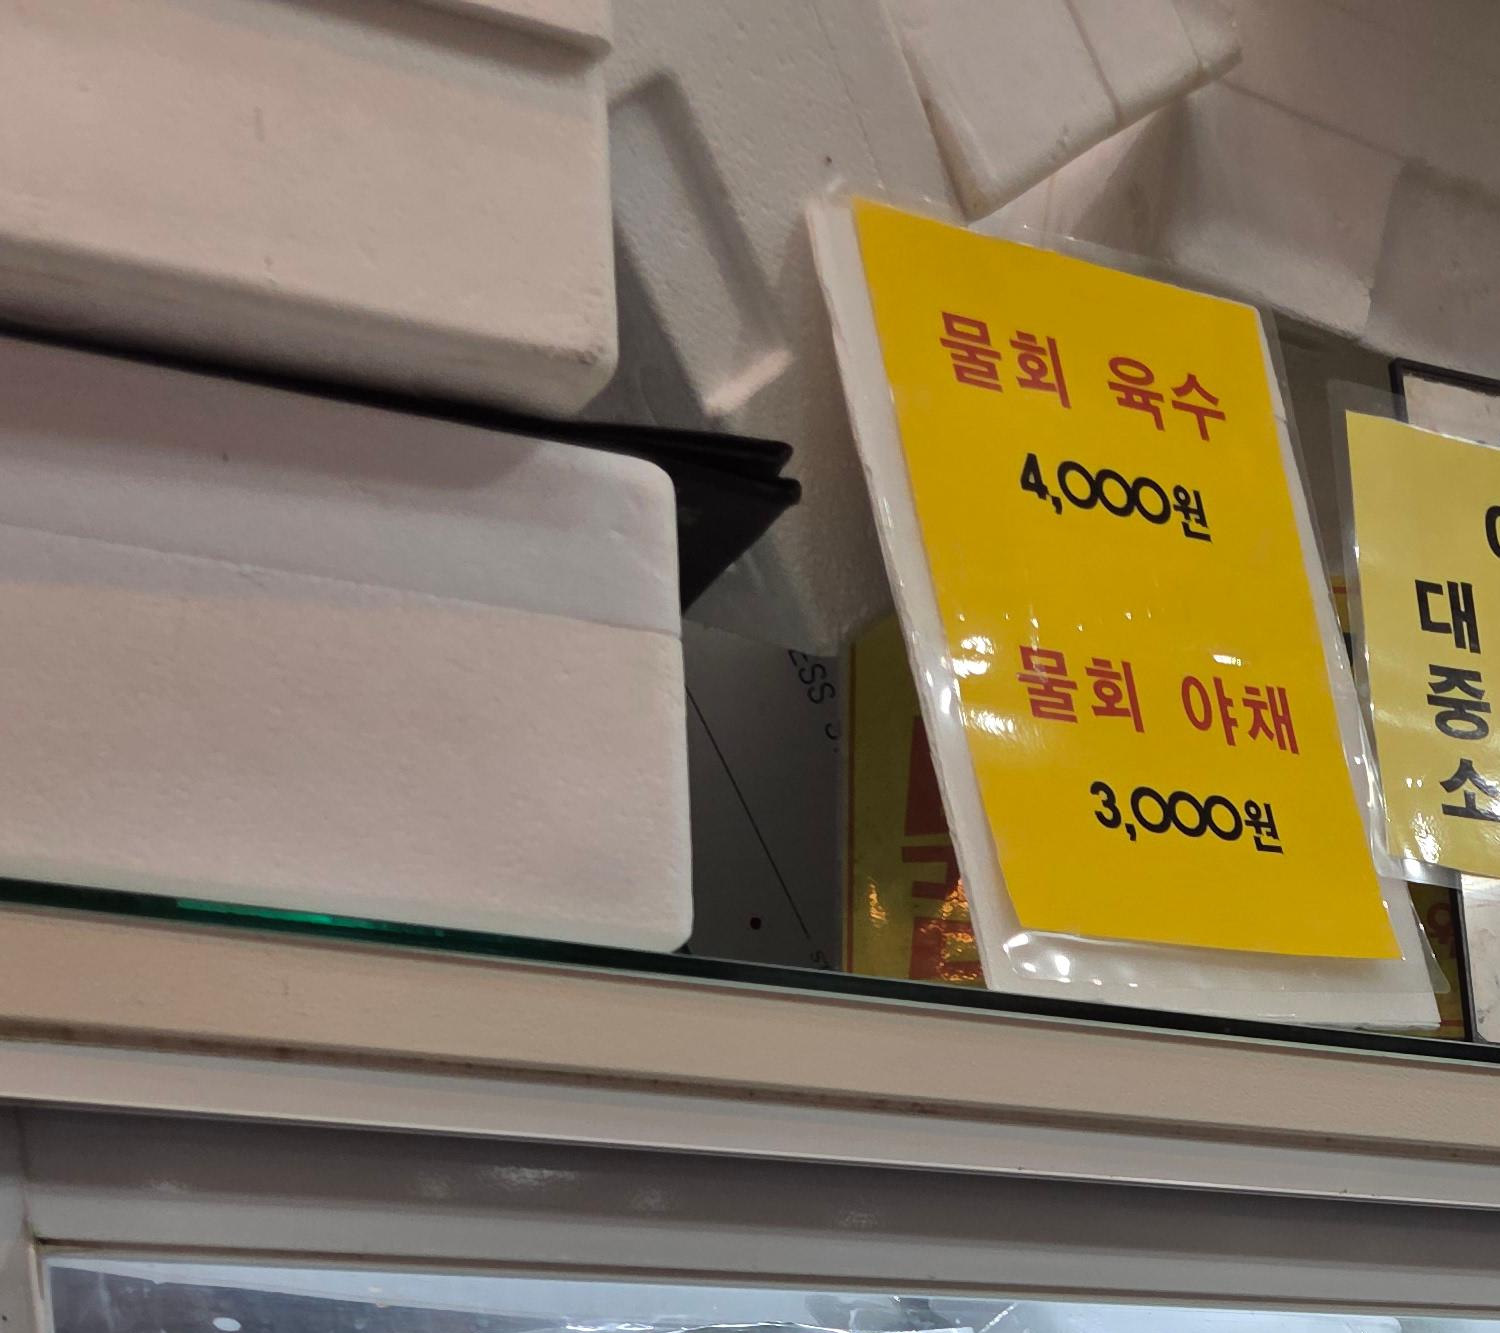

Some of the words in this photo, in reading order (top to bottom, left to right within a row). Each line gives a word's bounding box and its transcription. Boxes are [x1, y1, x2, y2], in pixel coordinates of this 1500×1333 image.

[939, 312, 1071, 408] 물회
[1107, 354, 1227, 440] 육수
[1021, 454, 1211, 542] 4,000원
[1415, 578, 1482, 654] 대
[1017, 645, 1145, 734] 물회
[1180, 676, 1299, 755] 야채
[1427, 664, 1492, 741] 중
[1090, 781, 1284, 854] 3,000원
